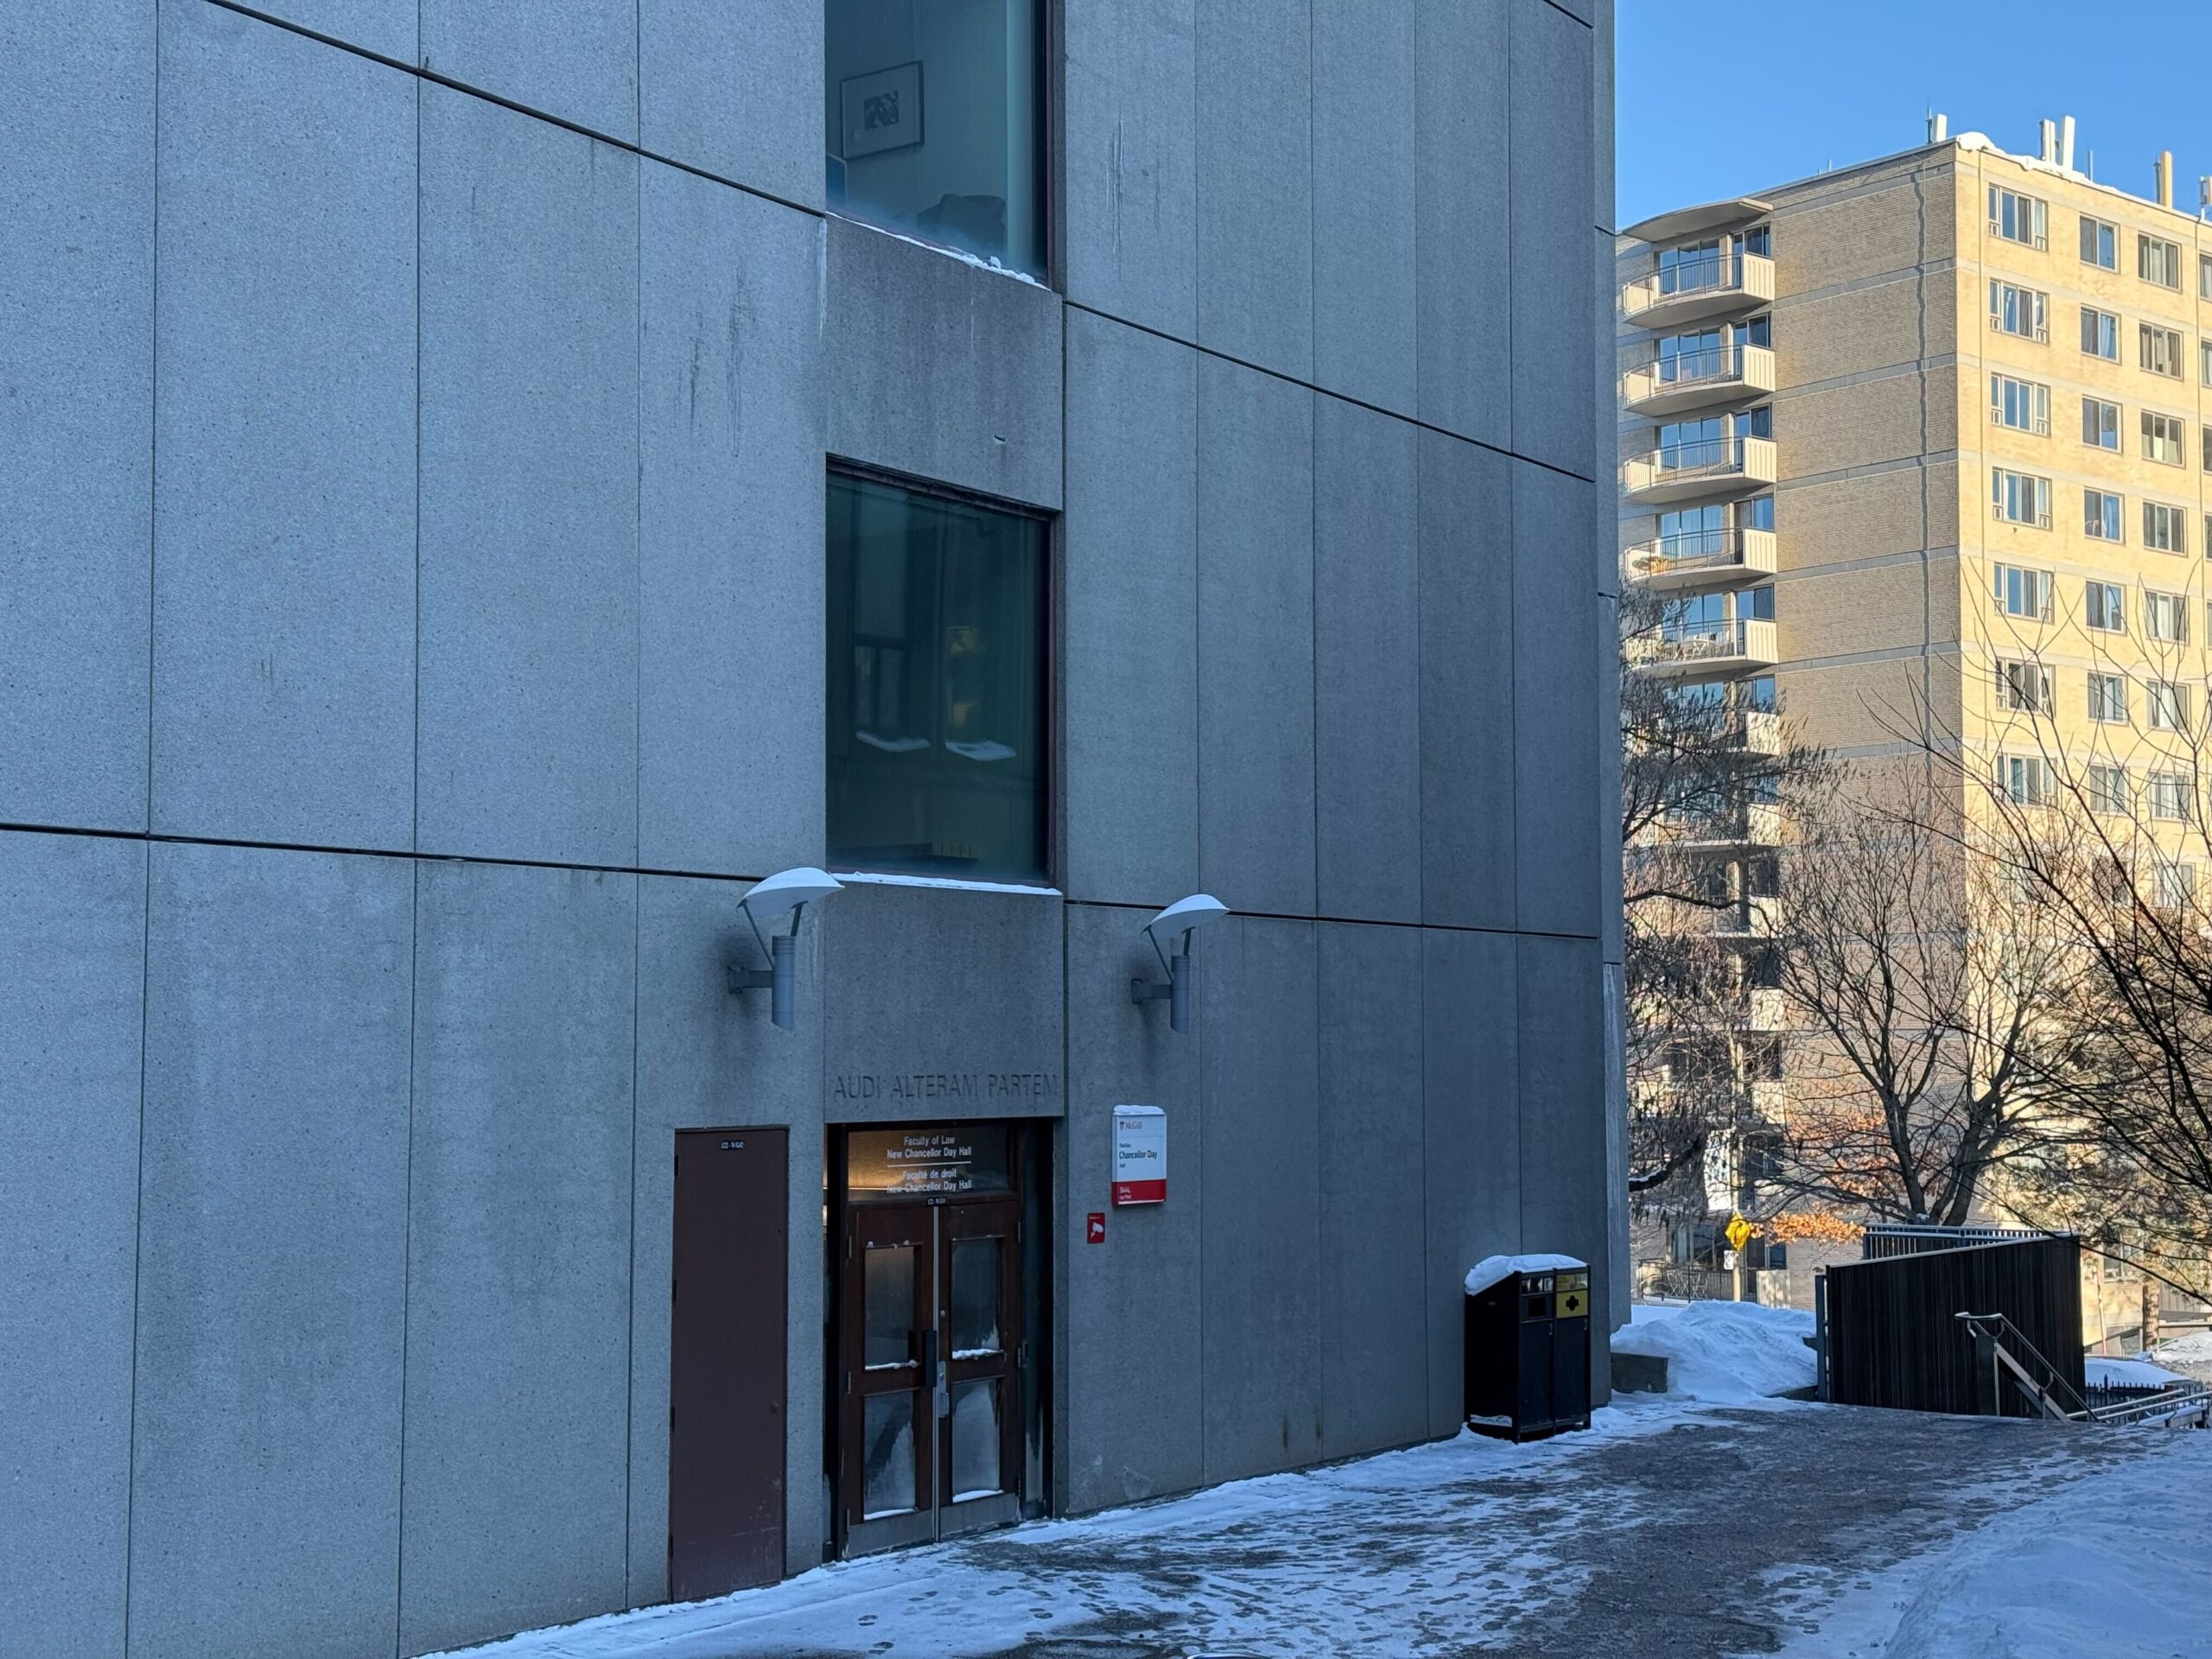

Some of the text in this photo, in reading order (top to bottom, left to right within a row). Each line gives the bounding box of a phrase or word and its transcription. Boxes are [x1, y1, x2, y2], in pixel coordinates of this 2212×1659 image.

[834, 1074, 1058, 1099] AUDI ALTERAM PARTEM
[904, 1135, 955, 1147] Faculty of Law
[887, 1147, 971, 1159] New Chancellor Day Hall
[1147, 1150, 1157, 1160] Day
[902, 1168, 957, 1179] Faculté de droit
[887, 1180, 971, 1193] New Chancellor Day Hall
